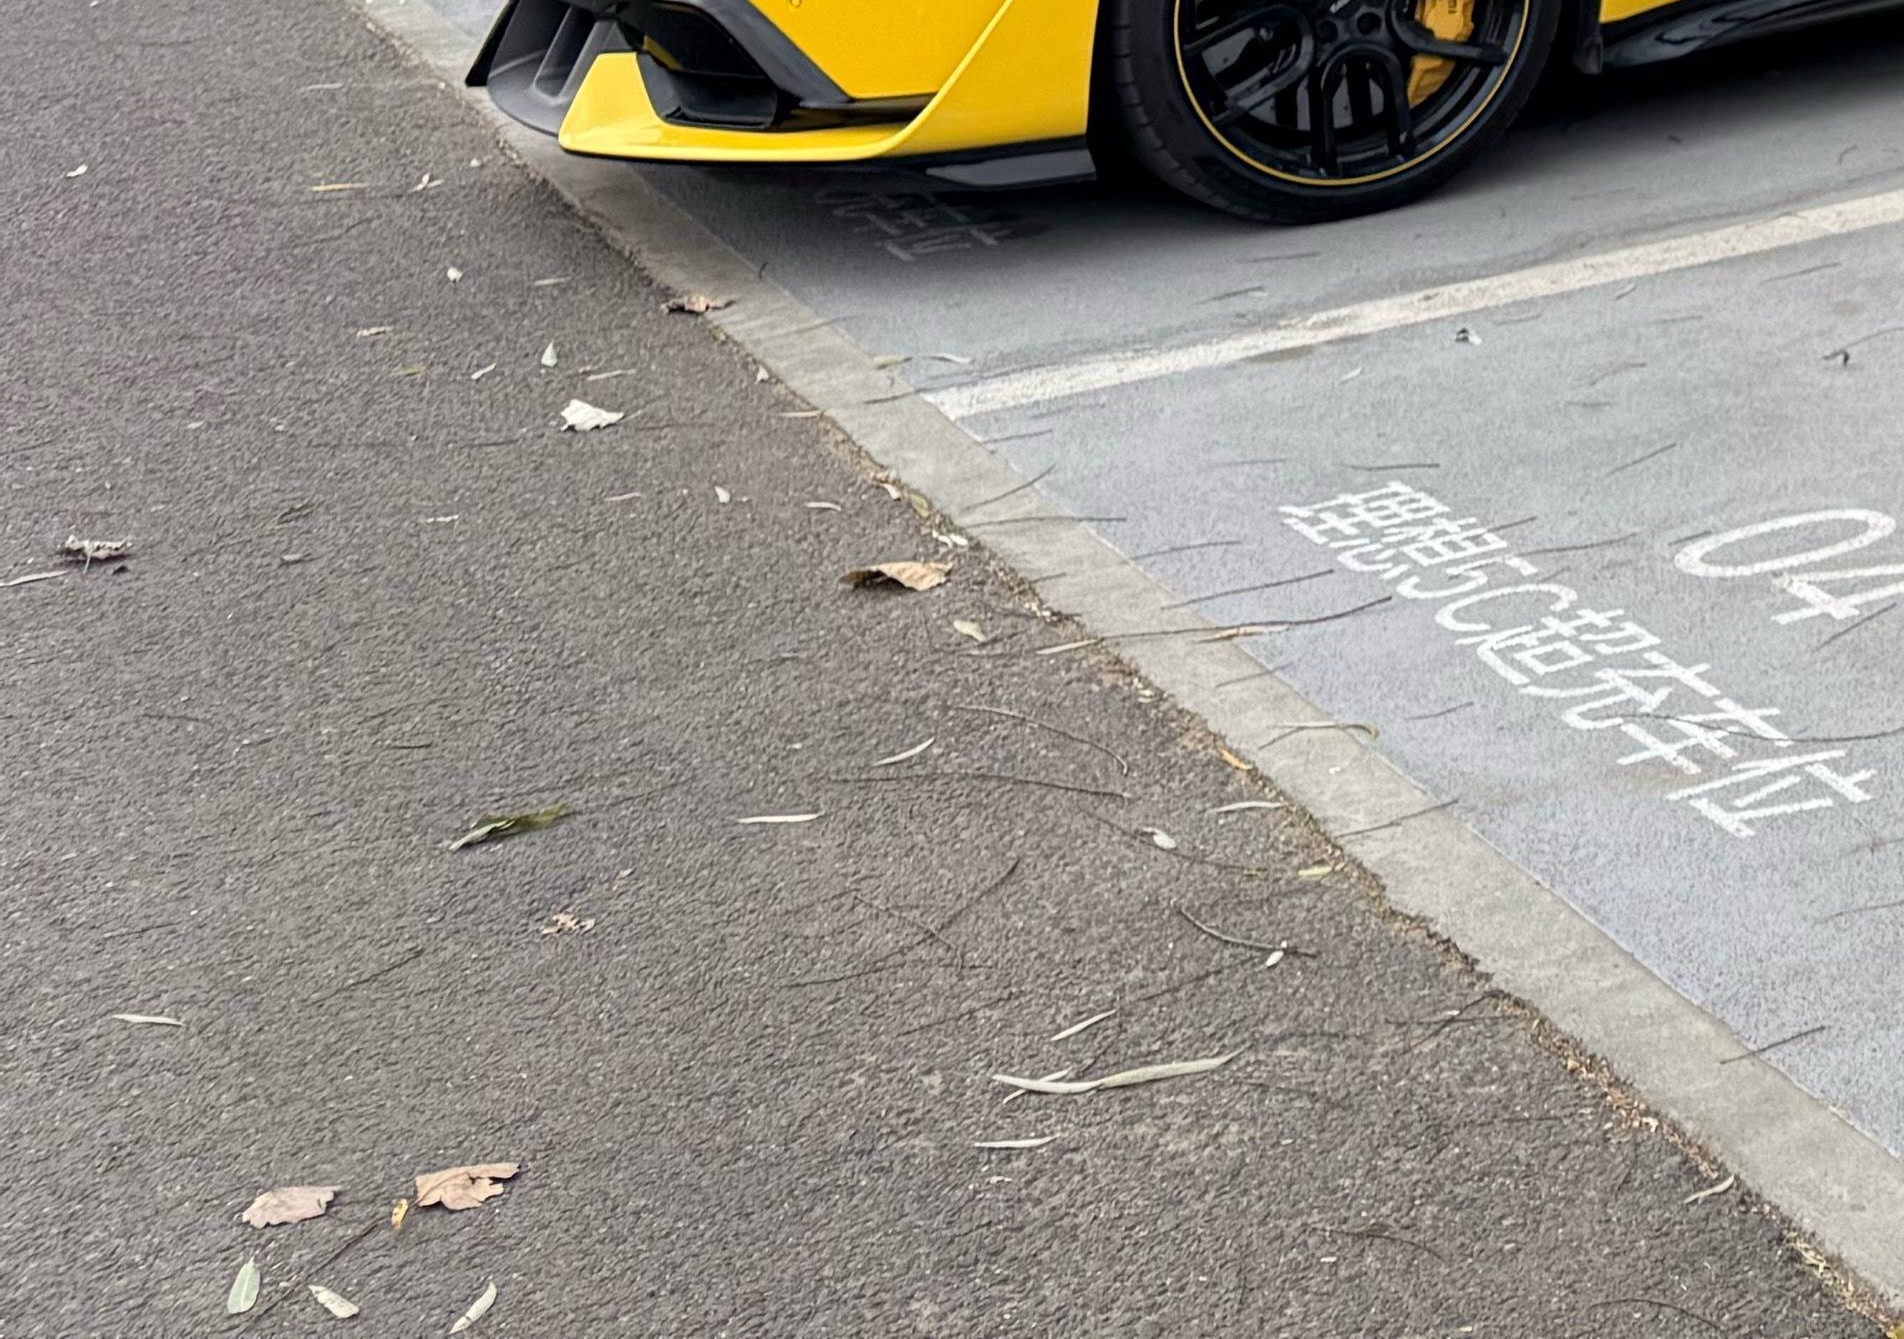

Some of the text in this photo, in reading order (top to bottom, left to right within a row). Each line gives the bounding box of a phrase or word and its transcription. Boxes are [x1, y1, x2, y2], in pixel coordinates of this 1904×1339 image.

[1278, 480, 1877, 839] 理想5C超充车位
